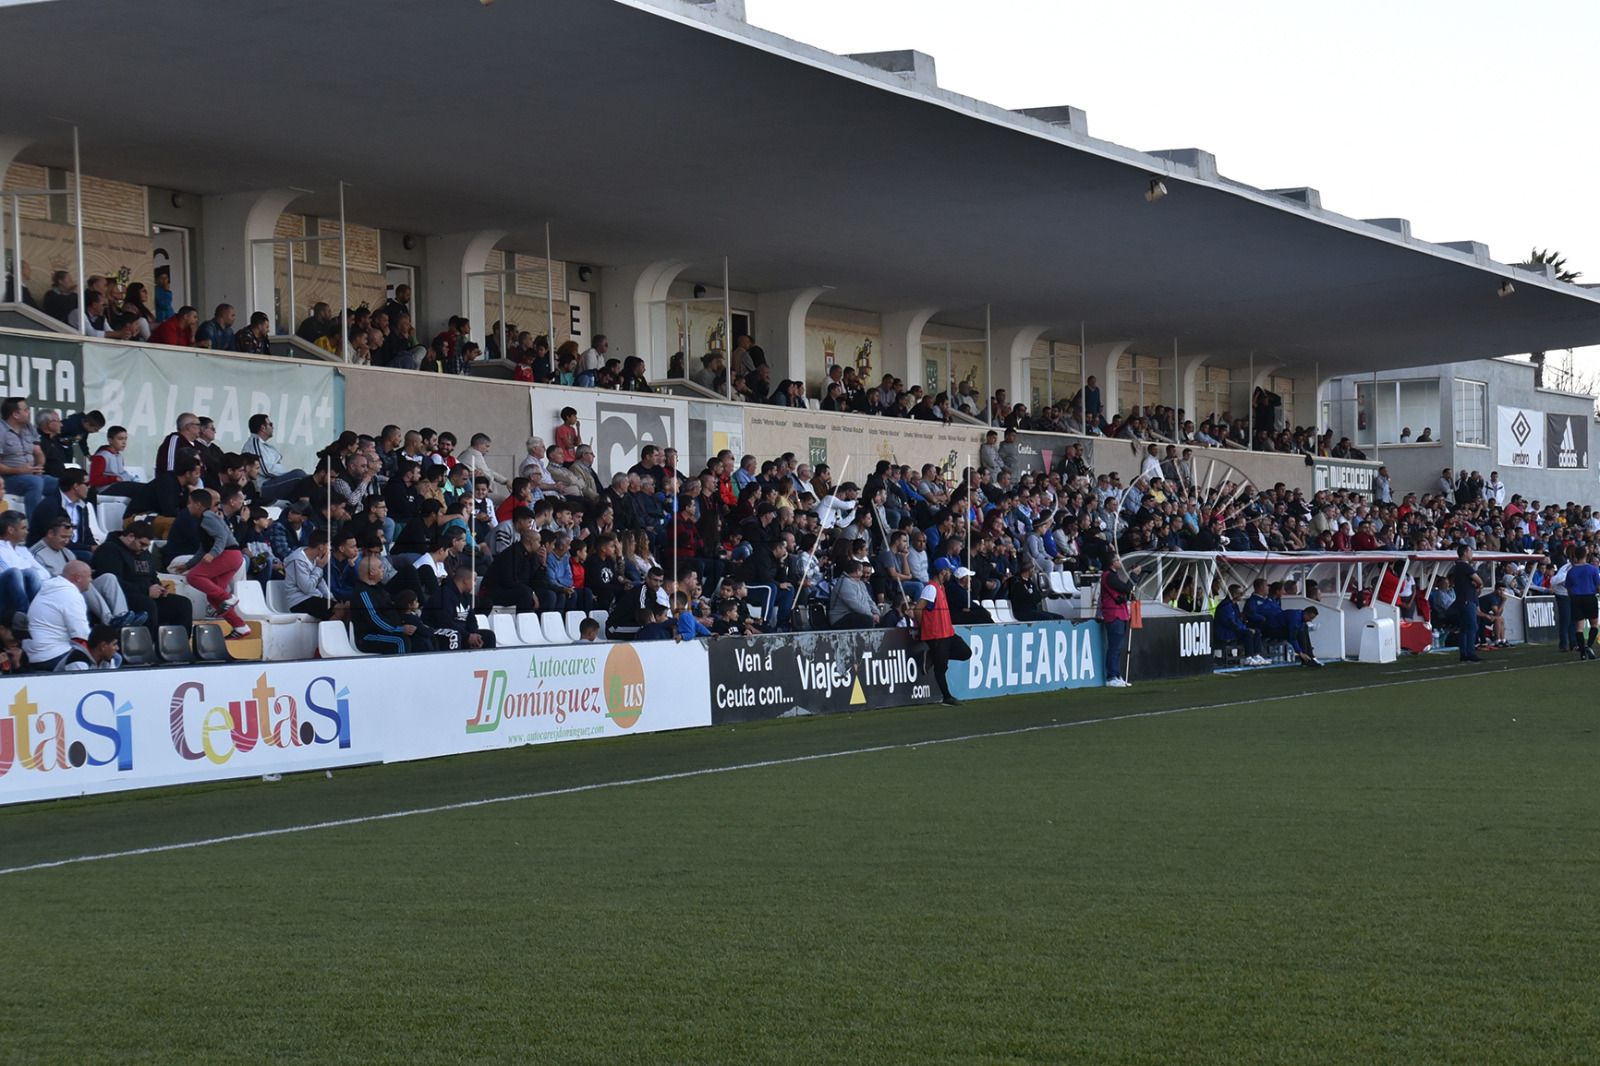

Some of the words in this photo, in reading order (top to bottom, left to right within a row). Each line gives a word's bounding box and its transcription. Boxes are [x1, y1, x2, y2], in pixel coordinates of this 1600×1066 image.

[570, 305, 581, 336] E
[1526, 601, 1556, 628] VISITANTE
[1179, 621, 1212, 657] LOCAL
[527, 653, 597, 679] Autocares
[734, 648, 762, 673] Ven
[796, 652, 853, 699] Viajes
[861, 649, 918, 694] Trujillo
[609, 675, 644, 710] Bus
[716, 683, 756, 709] Ceuta
[758, 685, 794, 706] con...
[911, 684, 931, 699] .com
